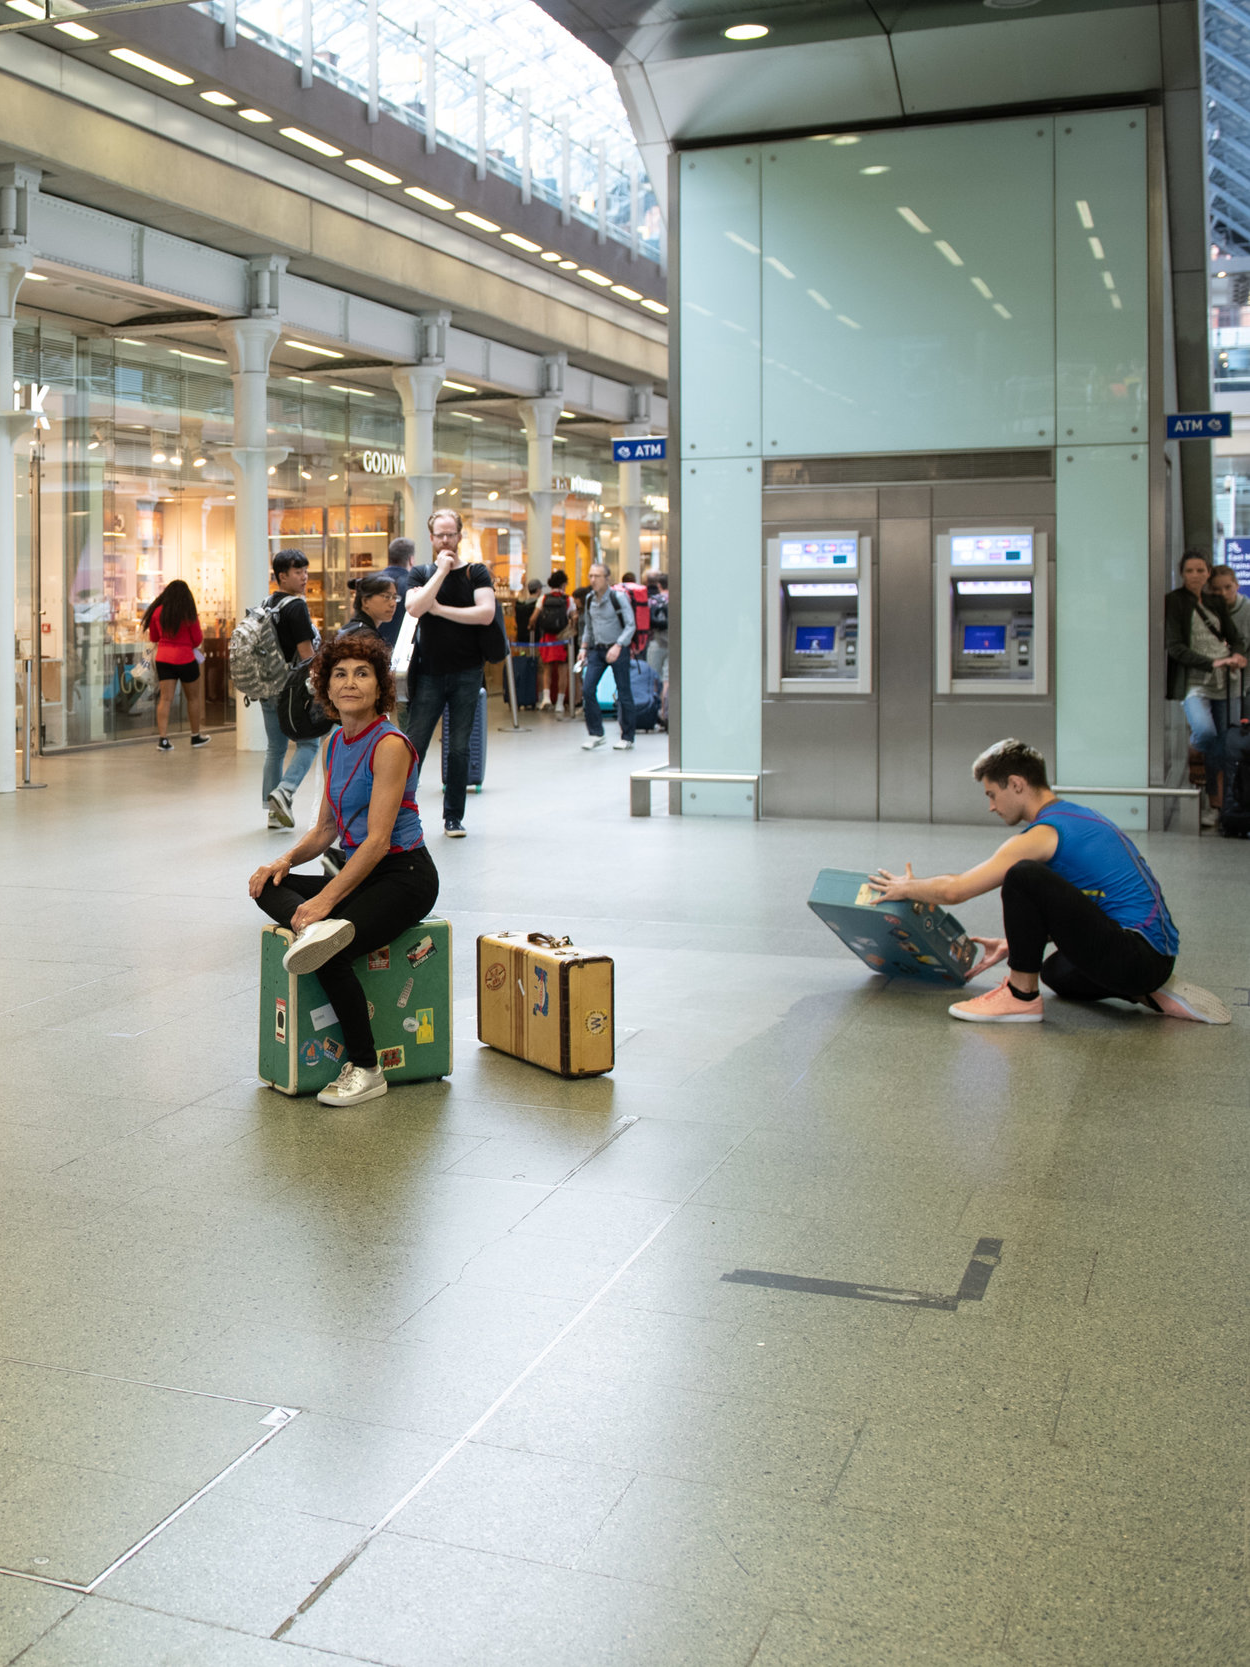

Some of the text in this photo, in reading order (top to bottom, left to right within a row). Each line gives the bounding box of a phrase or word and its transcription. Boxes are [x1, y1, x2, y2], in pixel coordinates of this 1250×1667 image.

[1173, 419, 1204, 433] ATM
[634, 443, 662, 458] ATM
[362, 449, 406, 475] GODIVA
